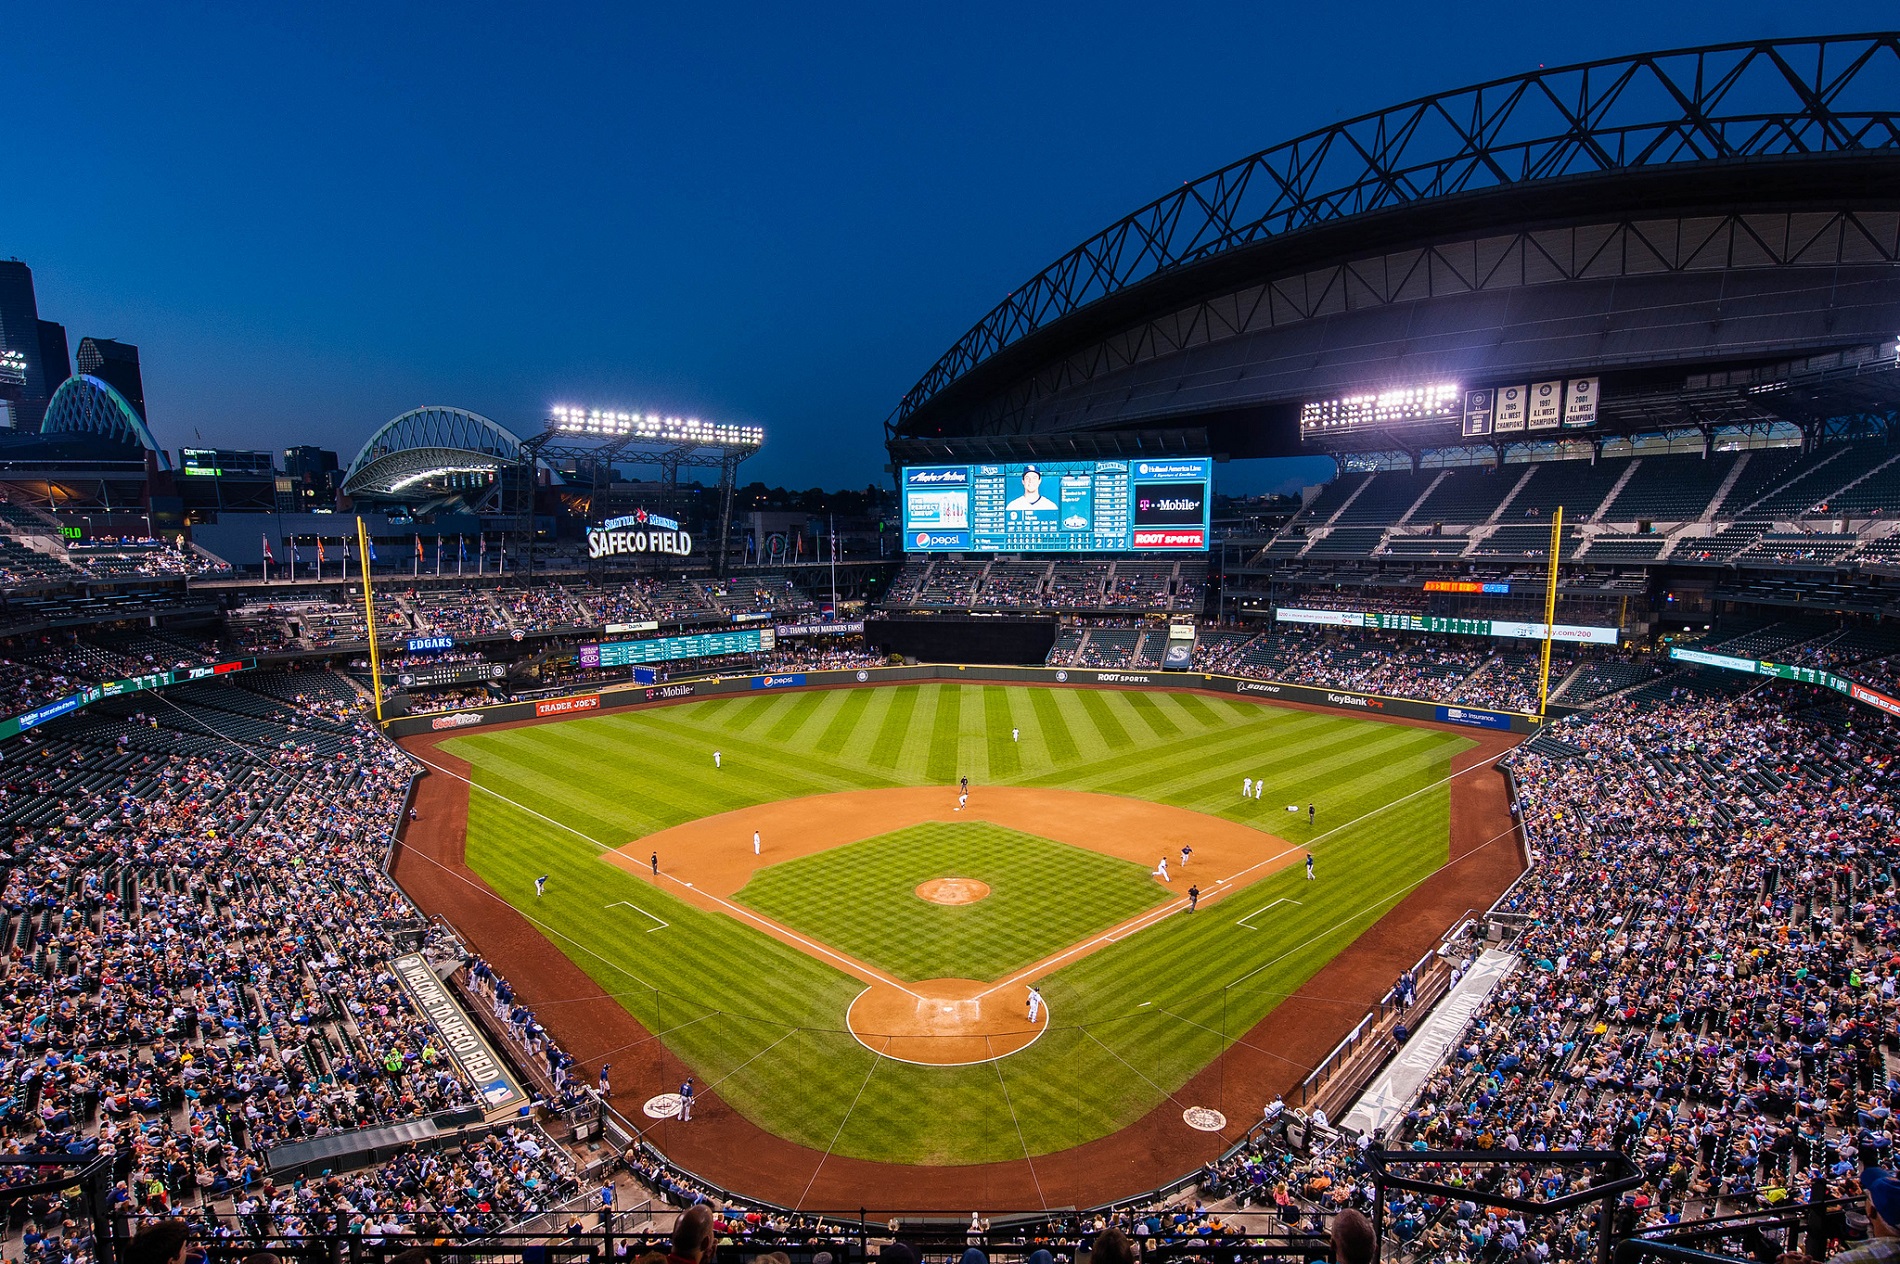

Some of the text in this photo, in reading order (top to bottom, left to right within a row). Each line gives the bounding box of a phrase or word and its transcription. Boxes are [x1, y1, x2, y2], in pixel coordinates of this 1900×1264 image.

[1530, 418, 1557, 426] CHAMPIONS
[1566, 414, 1594, 422] CHAMPIONS
[1497, 421, 1523, 429] CHAMPIONS
[1010, 511, 1018, 520] 9
[931, 536, 959, 545] pepsi
[1095, 539, 1124, 548] 2 2 2
[1135, 534, 1165, 544] ROOT
[588, 531, 692, 559] SAFECO FIELD
[848, 623, 862, 631] FANS!
[1544, 629, 1591, 637] ky.com/200
[409, 637, 452, 650] EDGARS
[189, 668, 205, 678] 710
[774, 676, 793, 685] pepsi
[1247, 683, 1280, 693] BOEING
[1836, 680, 1847, 692] MPH
[1328, 693, 1367, 707] KeyBank
[539, 698, 597, 713] TRADER JOE'S
[1468, 713, 1495, 722] Insurance
[433, 718, 457, 729] Coors
[403, 966, 500, 1082] WELCOME TO SAFECO FIELD
